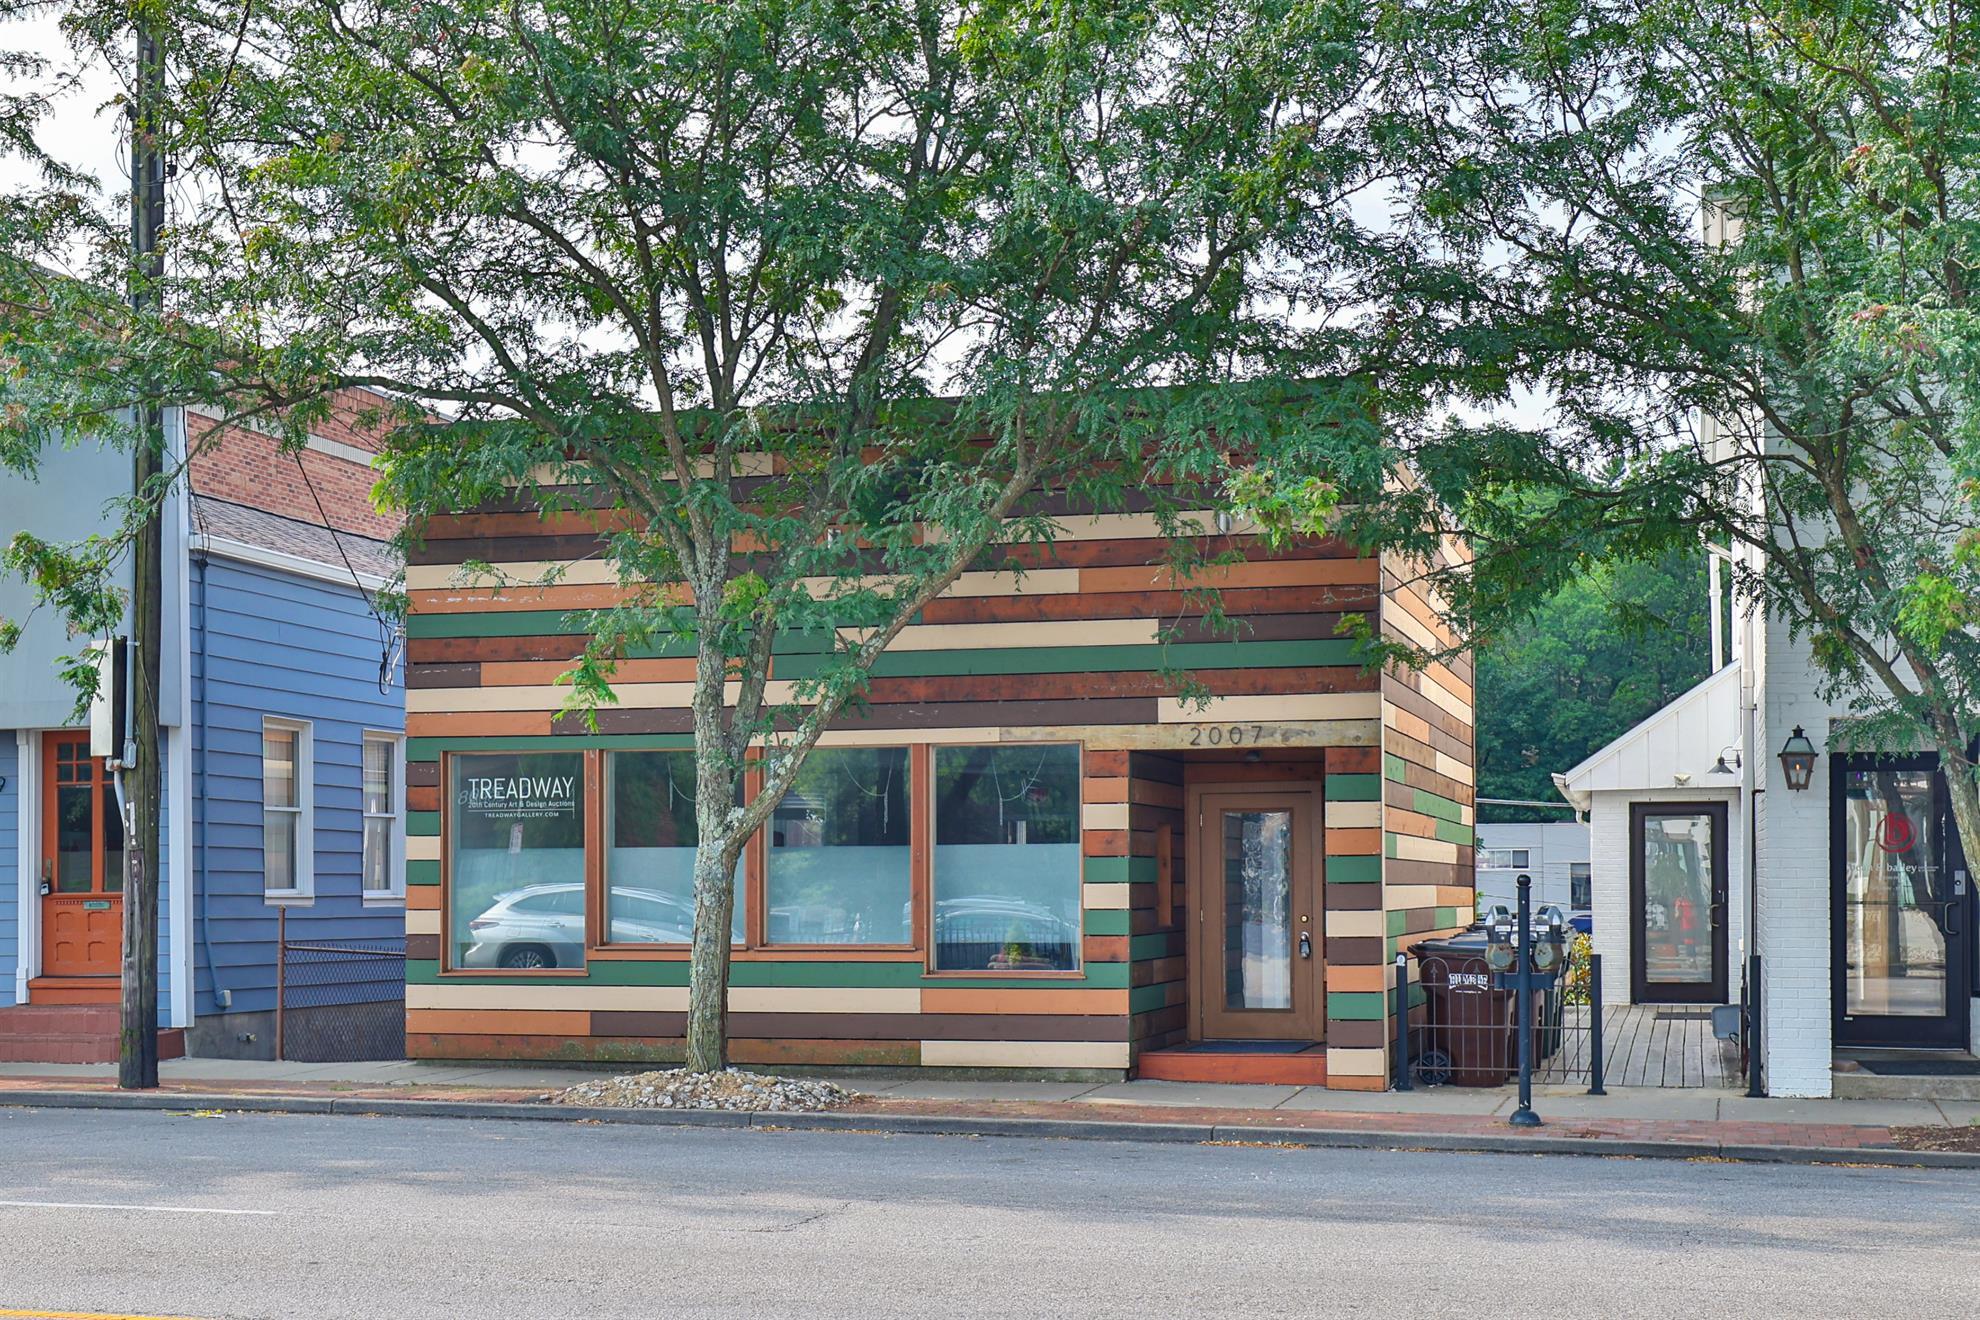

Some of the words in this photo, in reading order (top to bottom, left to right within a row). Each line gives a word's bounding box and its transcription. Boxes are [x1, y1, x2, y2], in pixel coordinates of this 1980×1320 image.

[1189, 725, 1263, 746] 2007
[468, 776, 574, 799] TREADWAY
[484, 800, 508, 809] Century
[508, 800, 518, 808] Art
[526, 800, 547, 808] Design
[1886, 863, 1917, 874] baley
